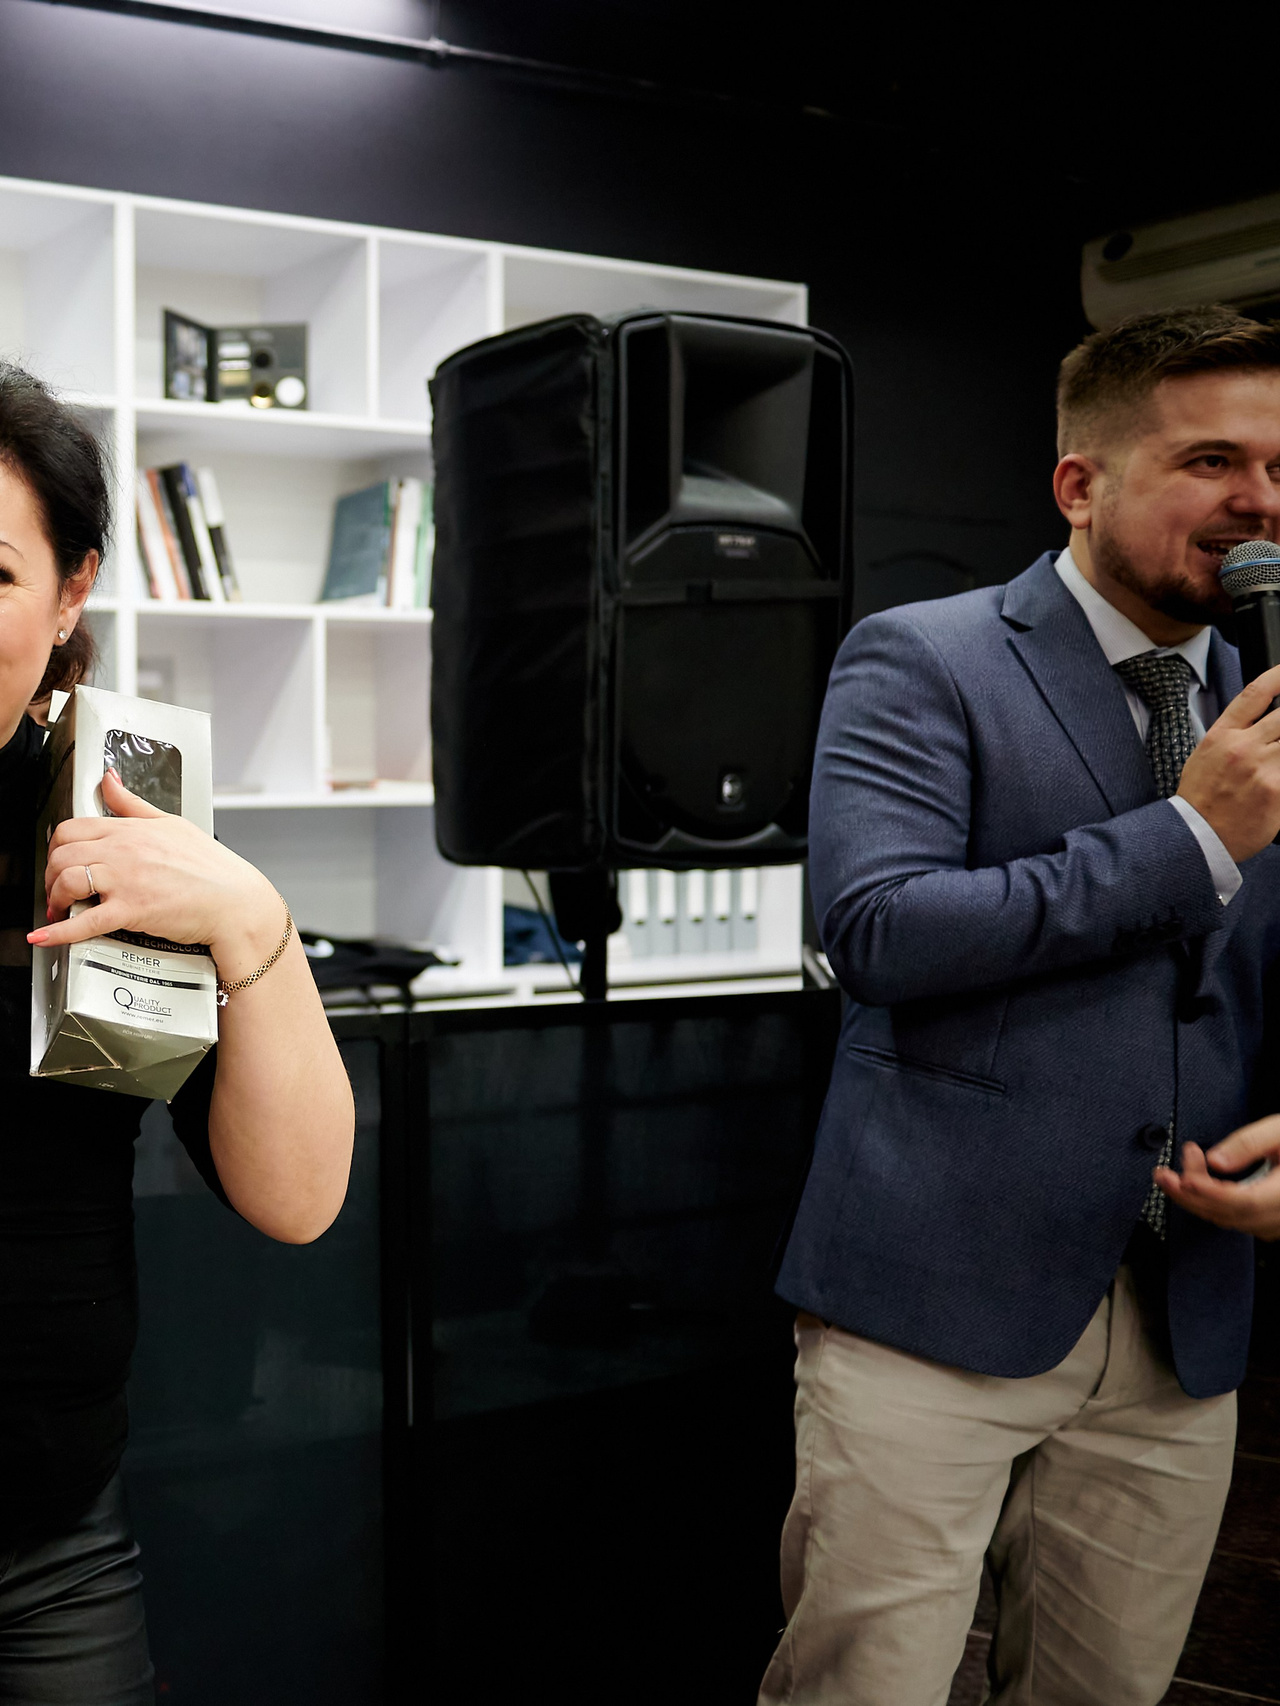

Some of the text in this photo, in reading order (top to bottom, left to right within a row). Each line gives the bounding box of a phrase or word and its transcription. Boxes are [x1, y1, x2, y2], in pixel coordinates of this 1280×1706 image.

[121, 951, 161, 968] REMER
[133, 1001, 172, 1014] PRODUCT
[121, 1010, 164, 1024] www.remer.eu
